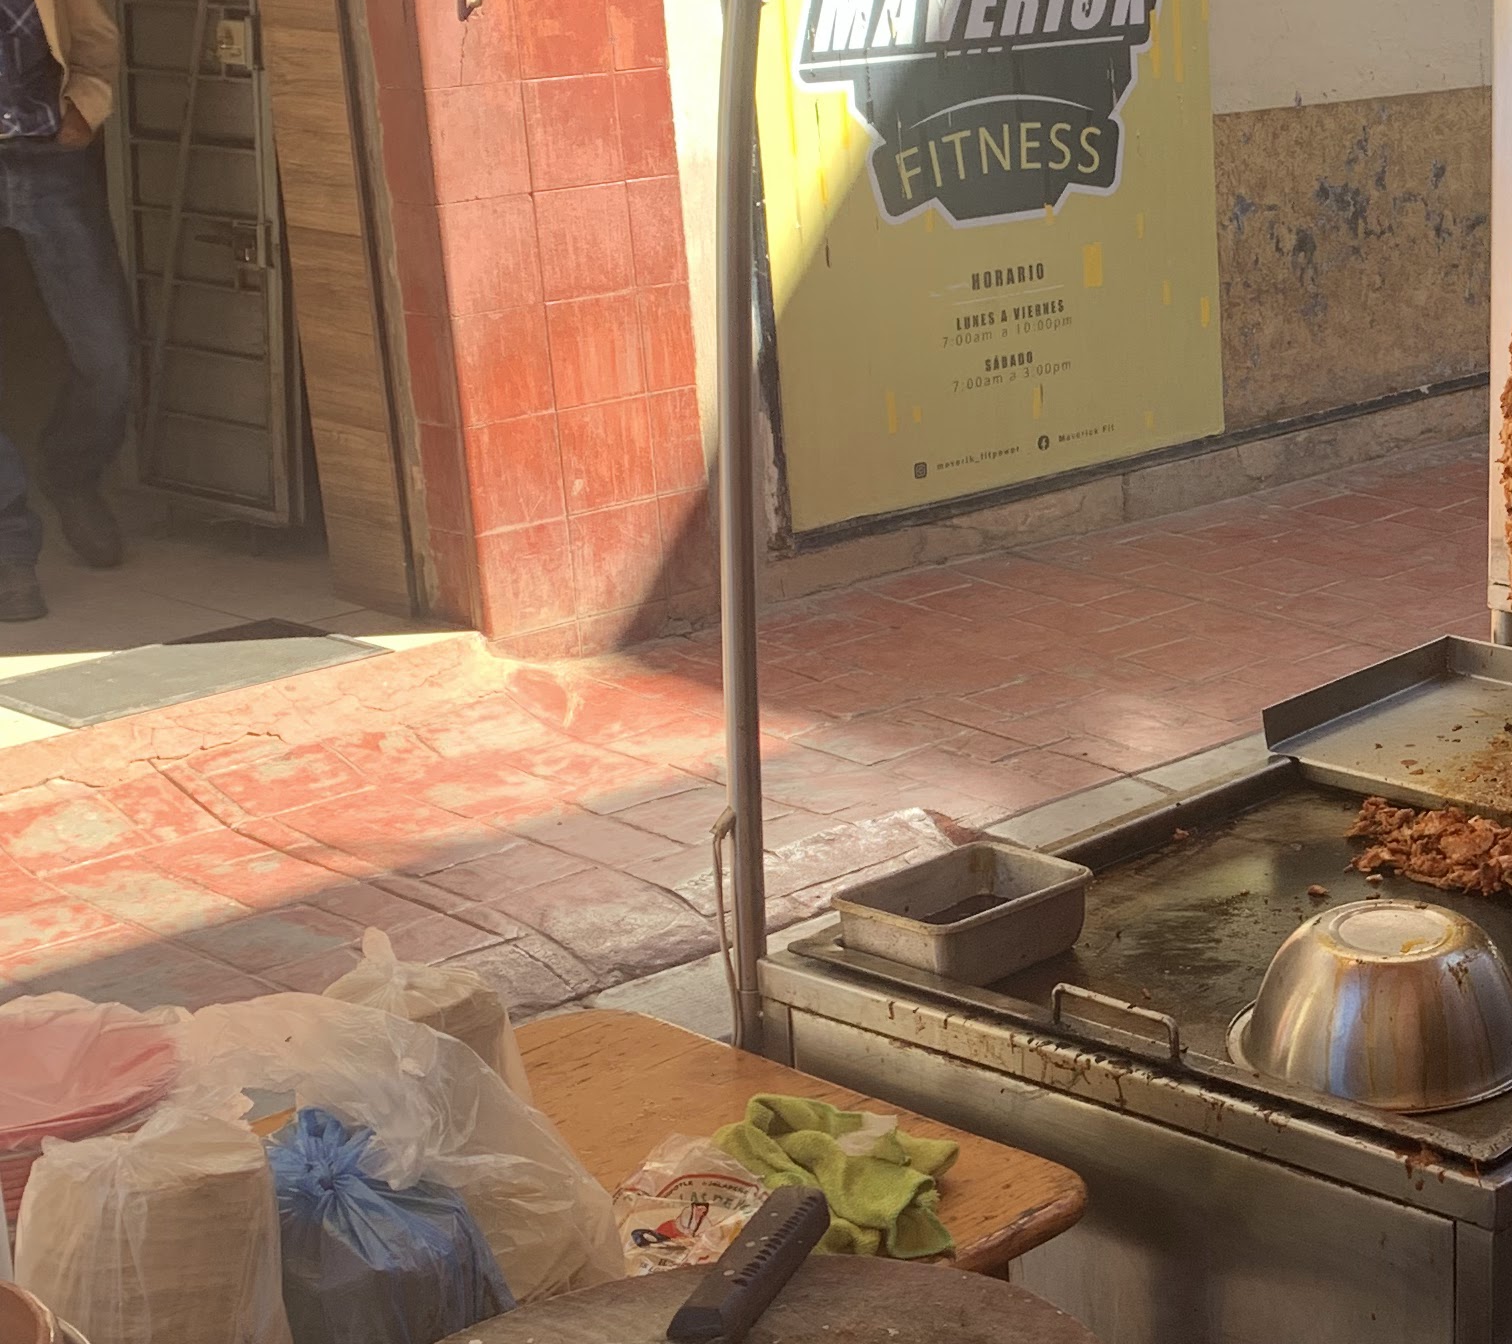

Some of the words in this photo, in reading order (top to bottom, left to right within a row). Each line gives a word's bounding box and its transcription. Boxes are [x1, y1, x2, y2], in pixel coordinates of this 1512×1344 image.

[895, 121, 1101, 200] FITNESS
[971, 262, 1044, 291] HORARIO
[956, 311, 995, 331] LUNES
[1000, 309, 1008, 323] A
[1013, 299, 1065, 320] VIERNES
[942, 330, 993, 349] 7:00am
[1001, 327, 1008, 338] a
[984, 350, 1033, 372] SÁBADO
[1009, 372, 1017, 382] a
